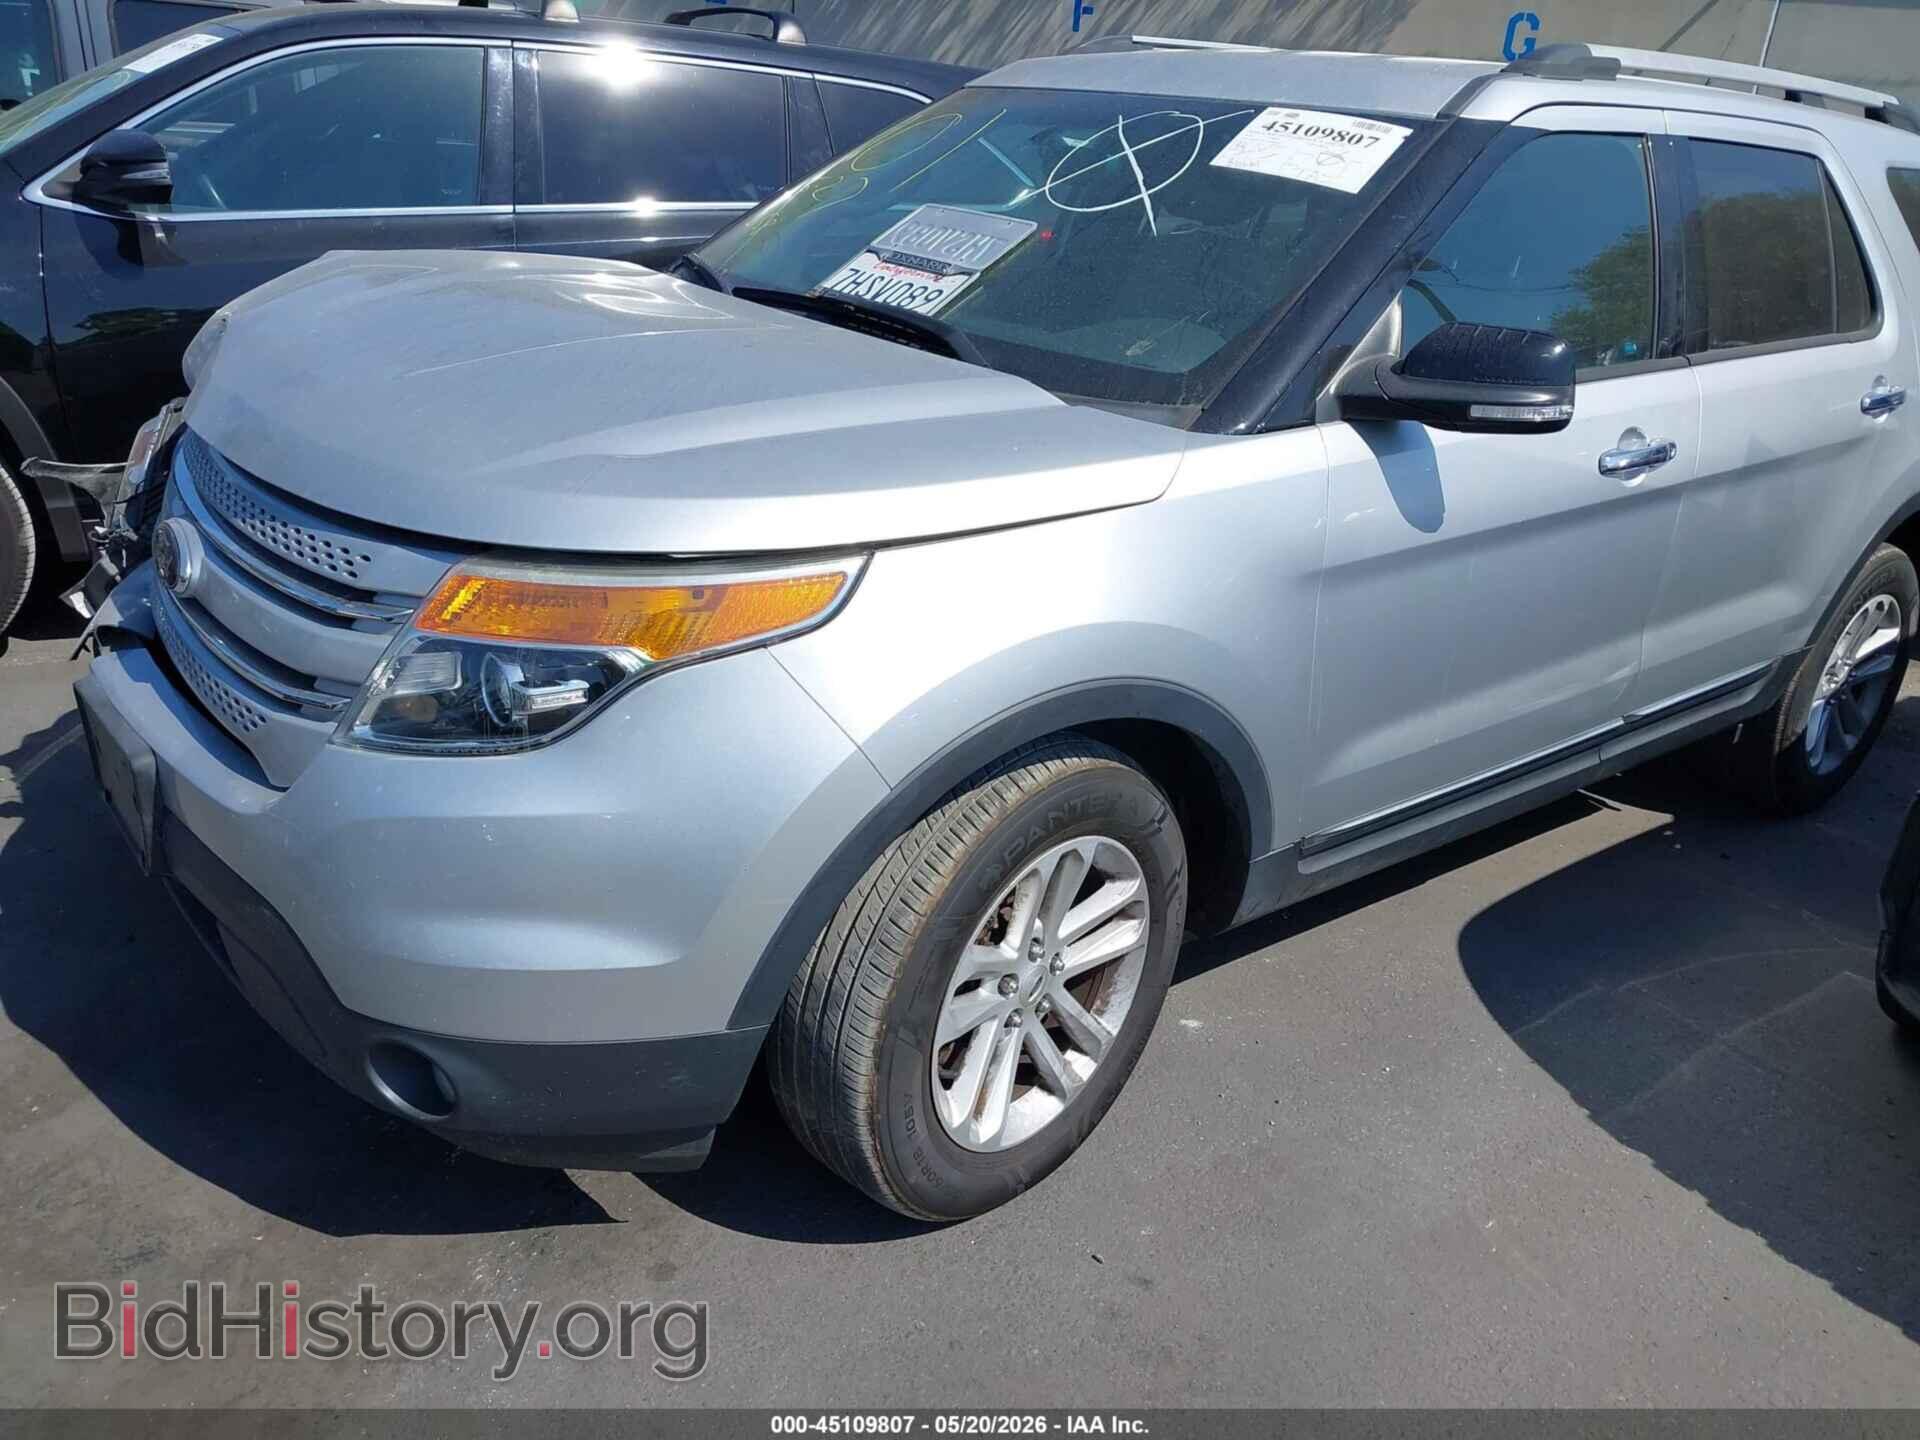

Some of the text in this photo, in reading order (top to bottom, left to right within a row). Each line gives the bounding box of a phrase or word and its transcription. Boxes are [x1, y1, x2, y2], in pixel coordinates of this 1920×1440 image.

[1503, 12, 1540, 61] G
[1262, 120, 1380, 149] 45109807
[831, 268, 944, 313] 7HSV089
